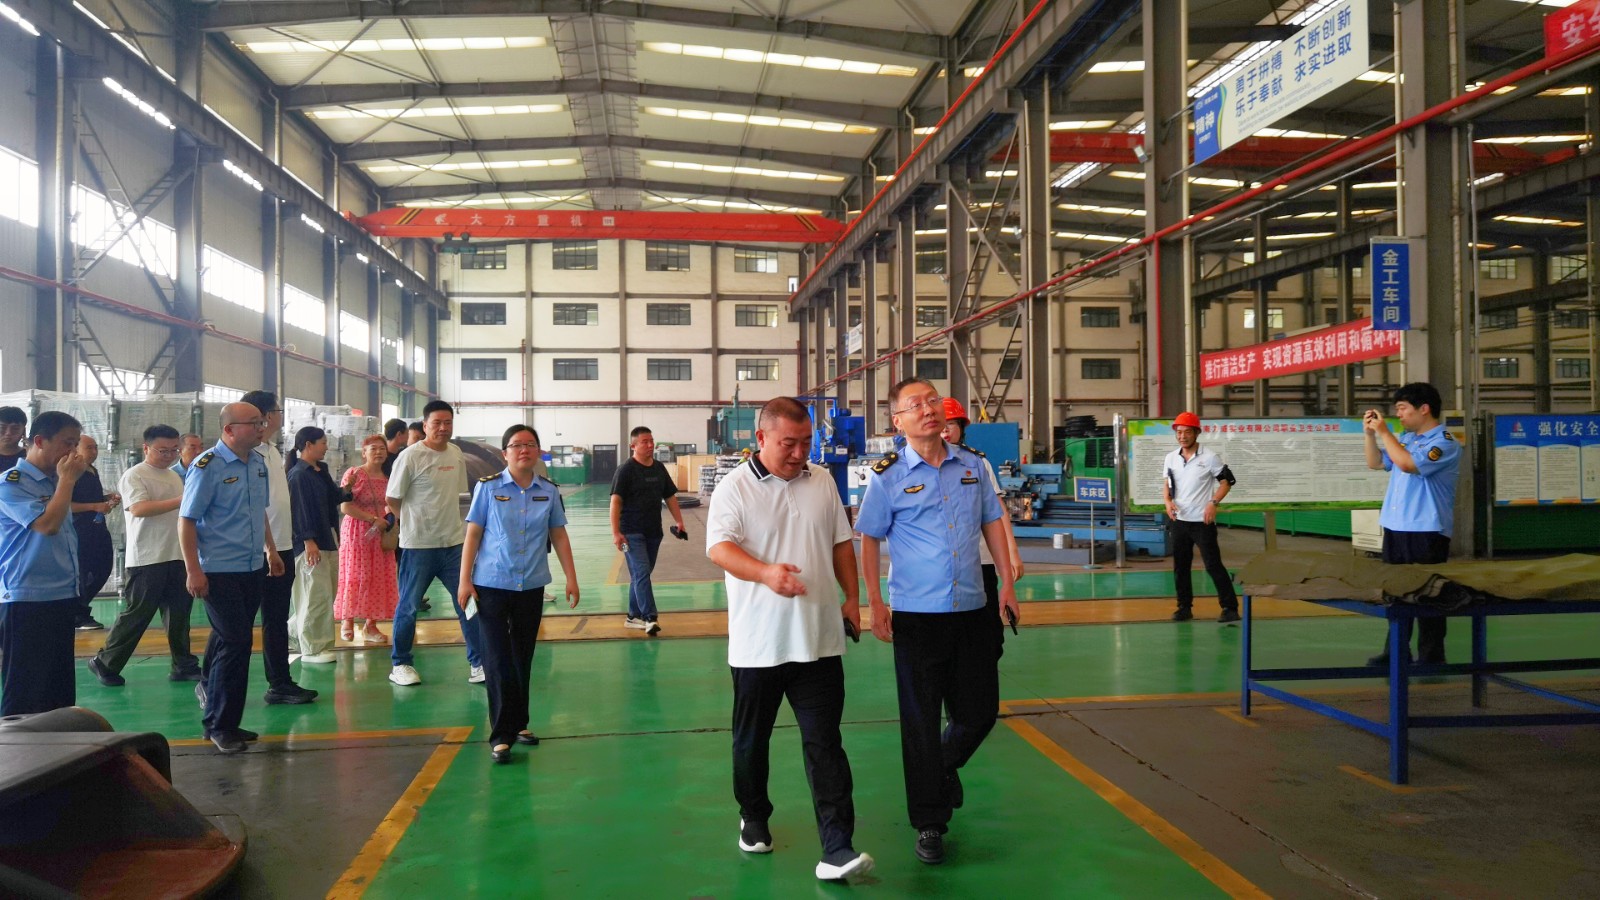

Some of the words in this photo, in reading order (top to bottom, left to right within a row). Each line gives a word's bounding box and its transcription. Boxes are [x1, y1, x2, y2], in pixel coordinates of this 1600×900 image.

[1236, 50, 1282, 97] 勇于拼搏
[1294, 5, 1351, 57] 不断创新
[1236, 74, 1282, 118] 乐于奉献
[1294, 32, 1351, 82] 求实进取
[471, 213, 583, 227] 大方重机
[1382, 249, 1399, 322] 金工车间
[1205, 352, 1256, 380] 推行清洁生产
[1538, 421, 1599, 437] 强化安全
[1080, 487, 1107, 498] 车床区
